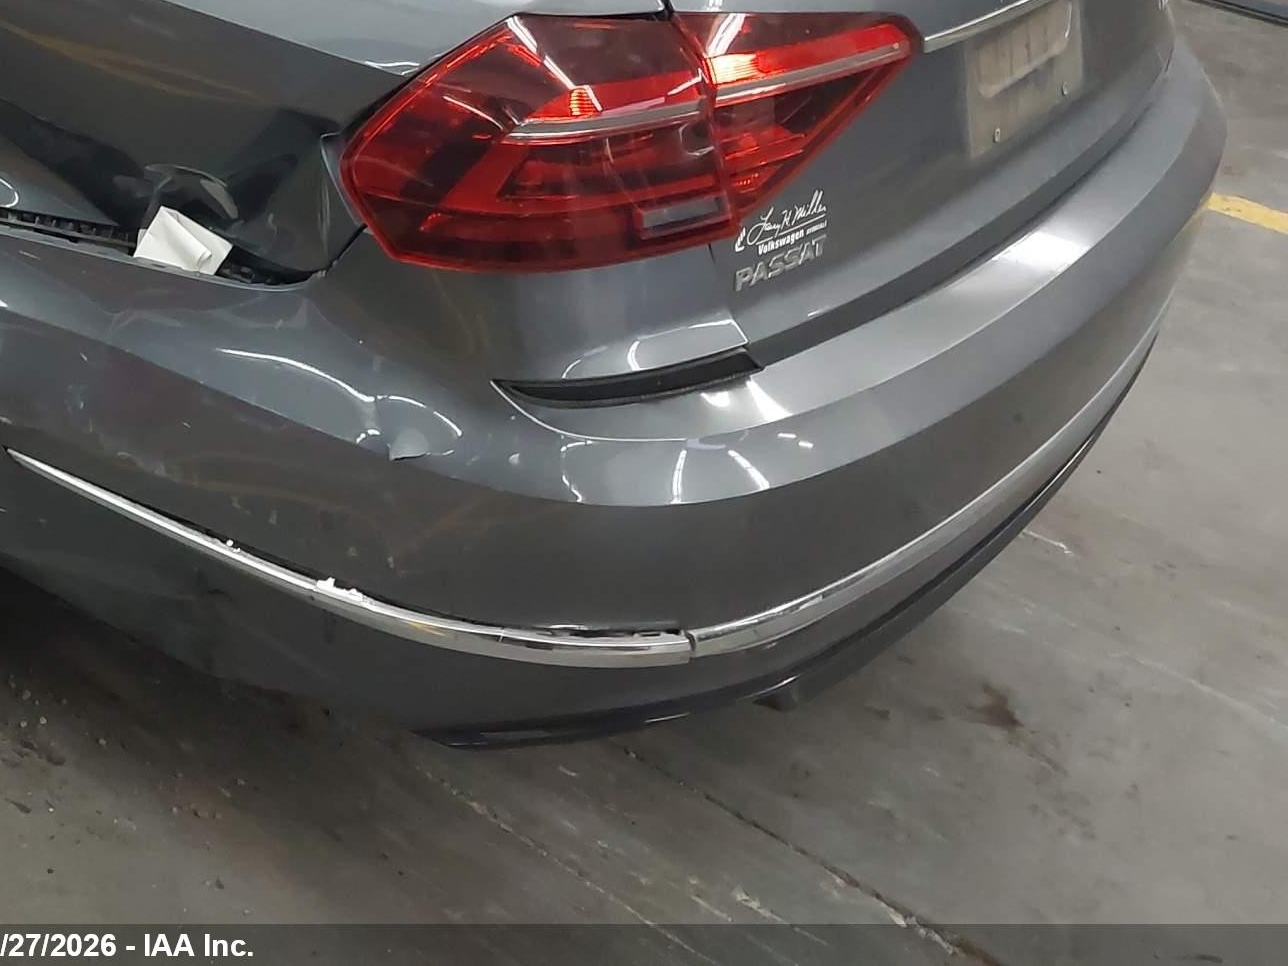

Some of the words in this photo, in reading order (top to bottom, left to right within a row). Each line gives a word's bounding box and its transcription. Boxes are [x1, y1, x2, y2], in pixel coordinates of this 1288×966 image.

[791, 189, 828, 226] Miller
[758, 229, 805, 255] Volkswagen
[735, 234, 827, 292] PASSAT
